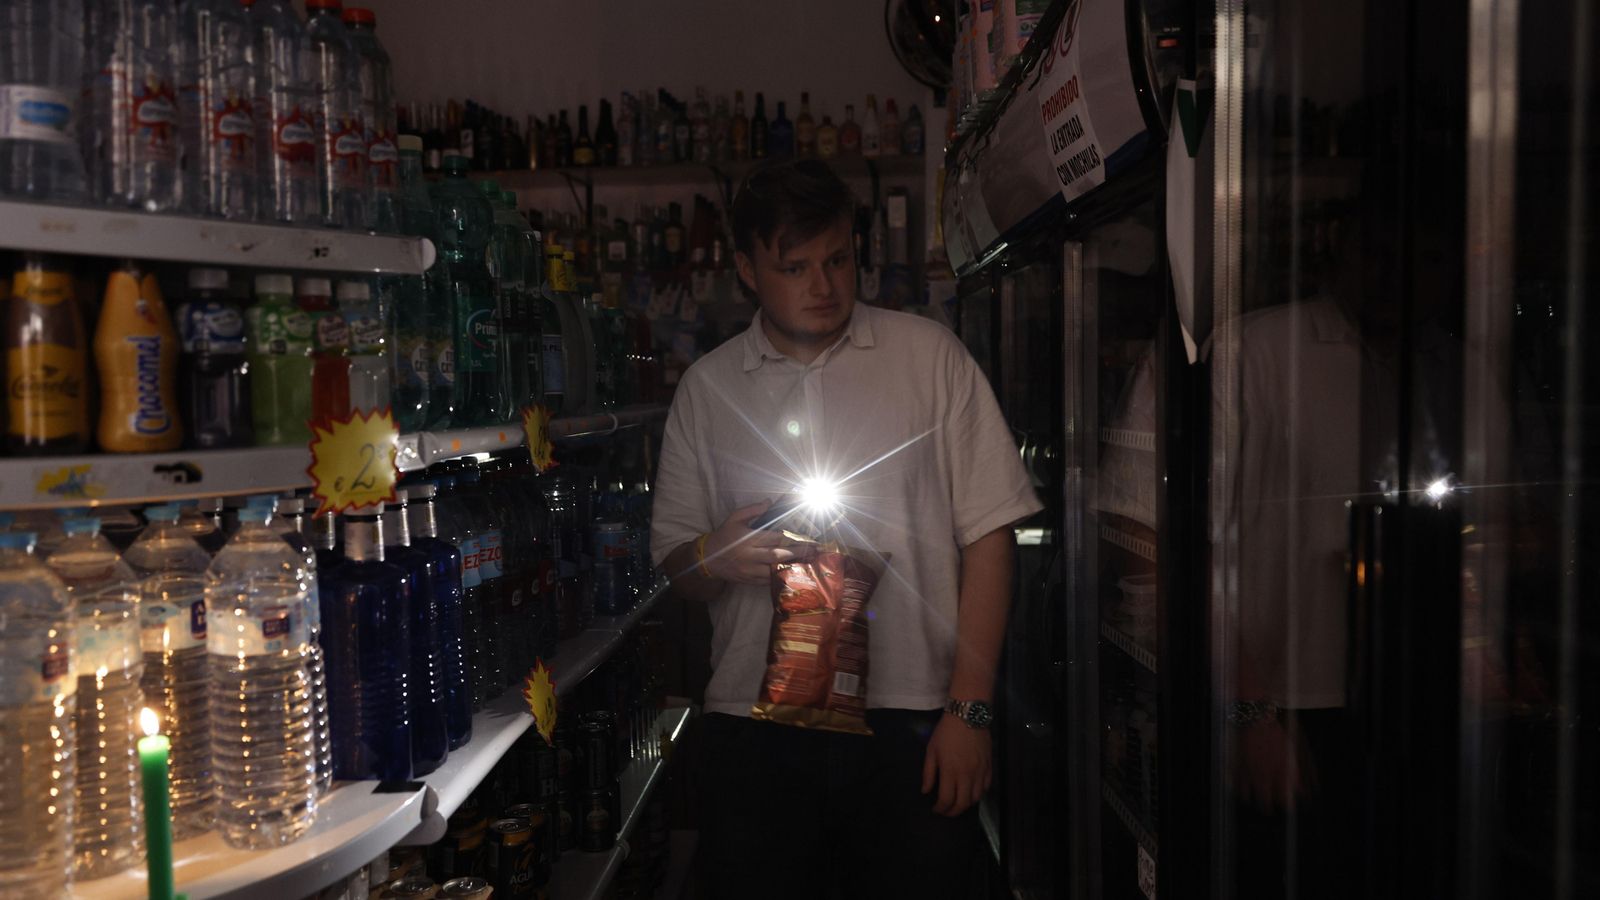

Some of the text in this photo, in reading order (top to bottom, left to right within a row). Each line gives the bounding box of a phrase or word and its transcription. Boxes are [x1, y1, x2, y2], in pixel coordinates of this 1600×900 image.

[1041, 75, 1079, 126] PROHIBIDO
[1050, 114, 1085, 155] LA ENTRADA
[1056, 143, 1101, 186] CON MOCHILAS
[127, 334, 172, 436] Chocomel
